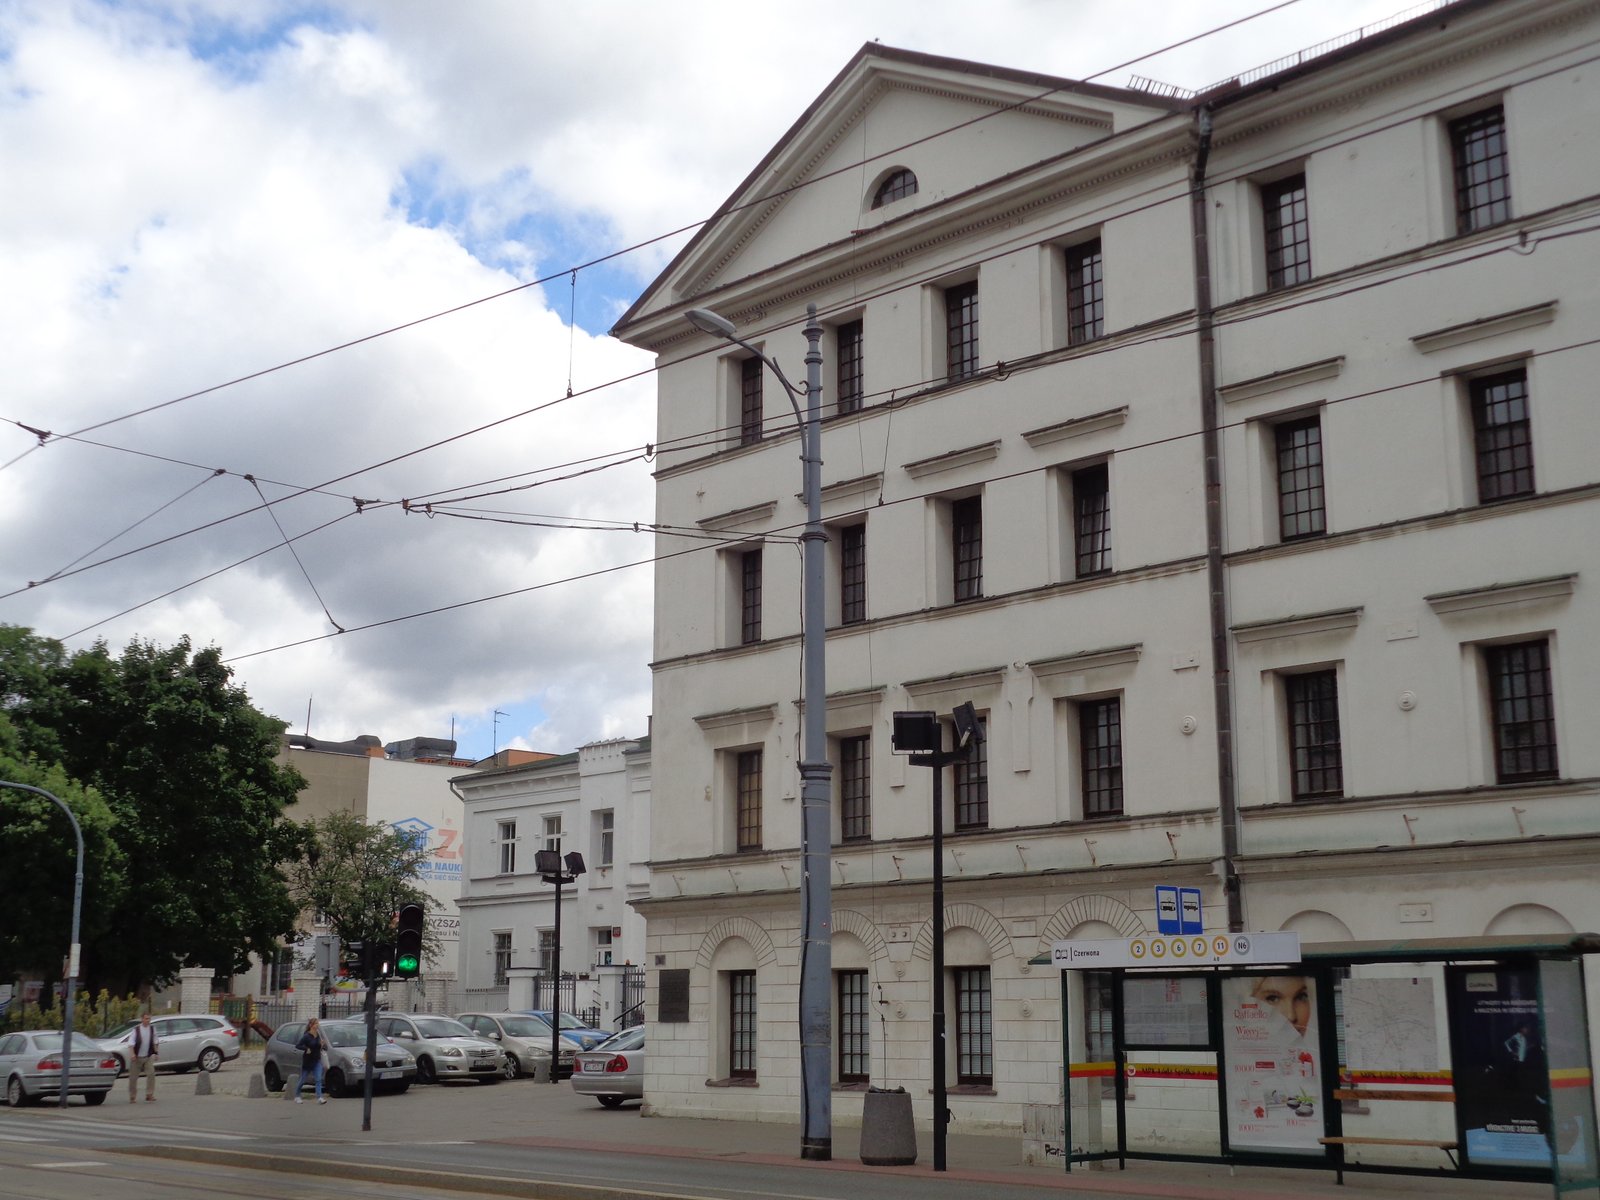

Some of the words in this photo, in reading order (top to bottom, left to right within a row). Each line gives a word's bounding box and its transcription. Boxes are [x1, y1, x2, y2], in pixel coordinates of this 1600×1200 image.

[434, 818, 464, 859] Ż
[1073, 949, 1100, 957] Czerwona
[1135, 945, 1141, 953] 2
[1156, 944, 1162, 953] 3
[1176, 944, 1182, 952] 6
[1197, 943, 1202, 951] 7
[1217, 942, 1224, 950] 11
[1237, 942, 1247, 950] N6
